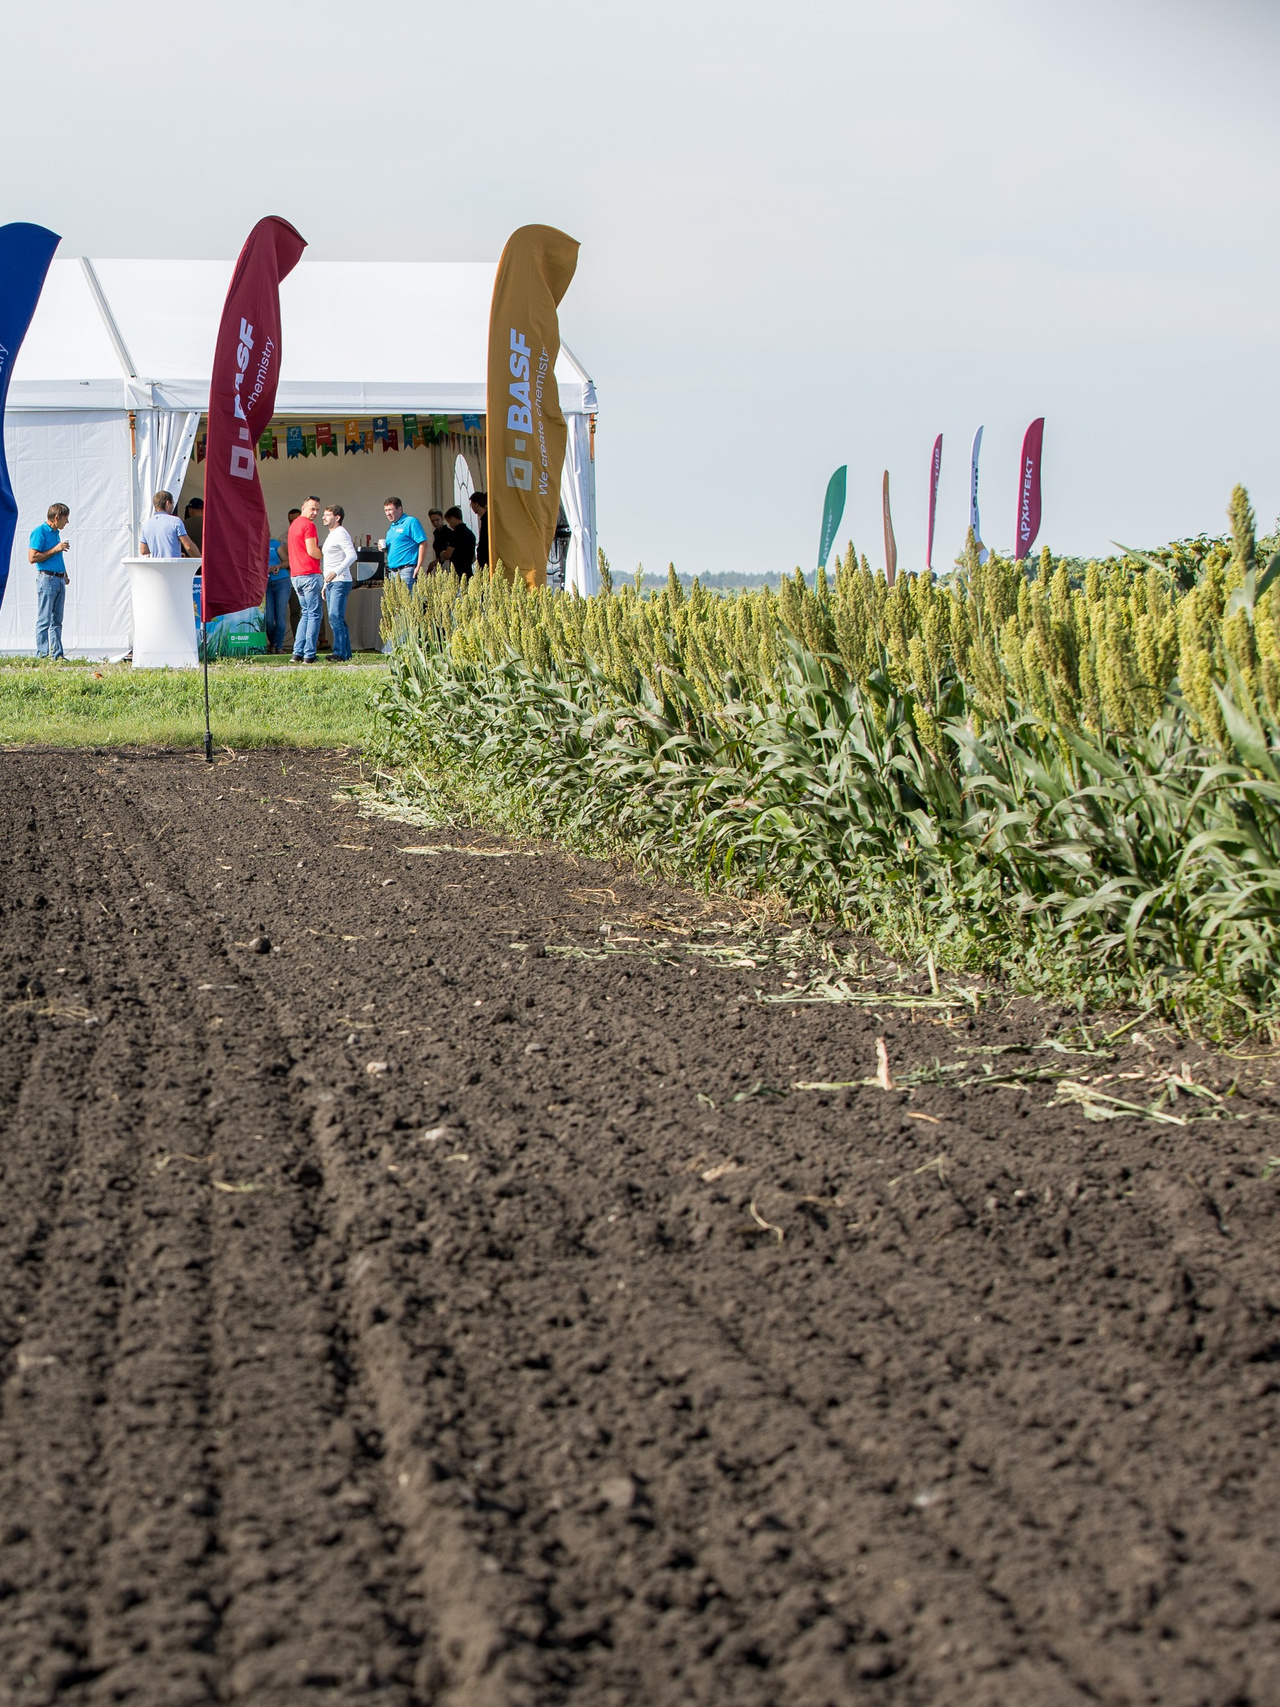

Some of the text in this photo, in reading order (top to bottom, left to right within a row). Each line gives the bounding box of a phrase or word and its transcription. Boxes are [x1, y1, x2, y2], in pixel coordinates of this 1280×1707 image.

[507, 328, 533, 434] BASF
[534, 347, 550, 495] We create chemistr
[1021, 456, 1034, 541] АРХИТЕКТ
